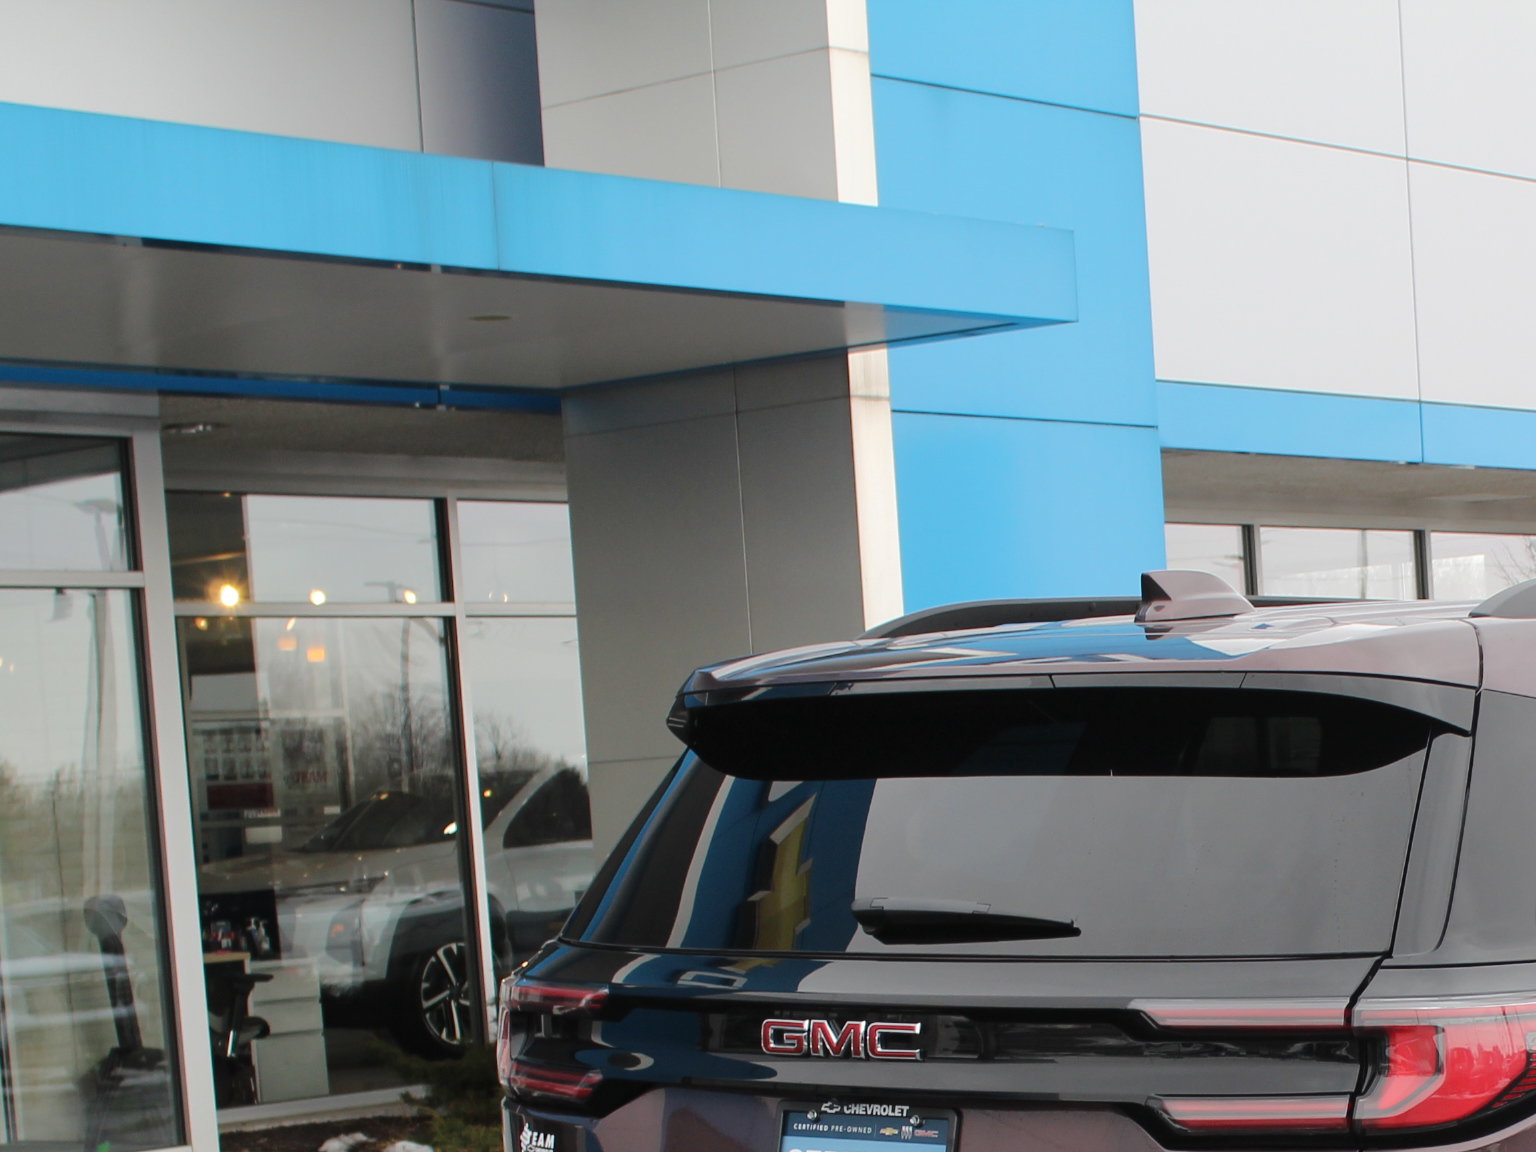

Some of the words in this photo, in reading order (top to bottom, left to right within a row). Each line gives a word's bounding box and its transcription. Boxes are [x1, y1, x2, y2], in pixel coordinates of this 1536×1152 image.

[761, 1018, 922, 1060] GMC
[843, 1103, 909, 1117] CHEVROLET
[793, 1122, 829, 1132] CERTIFIED
[830, 1125, 872, 1135] PRE-OWNED
